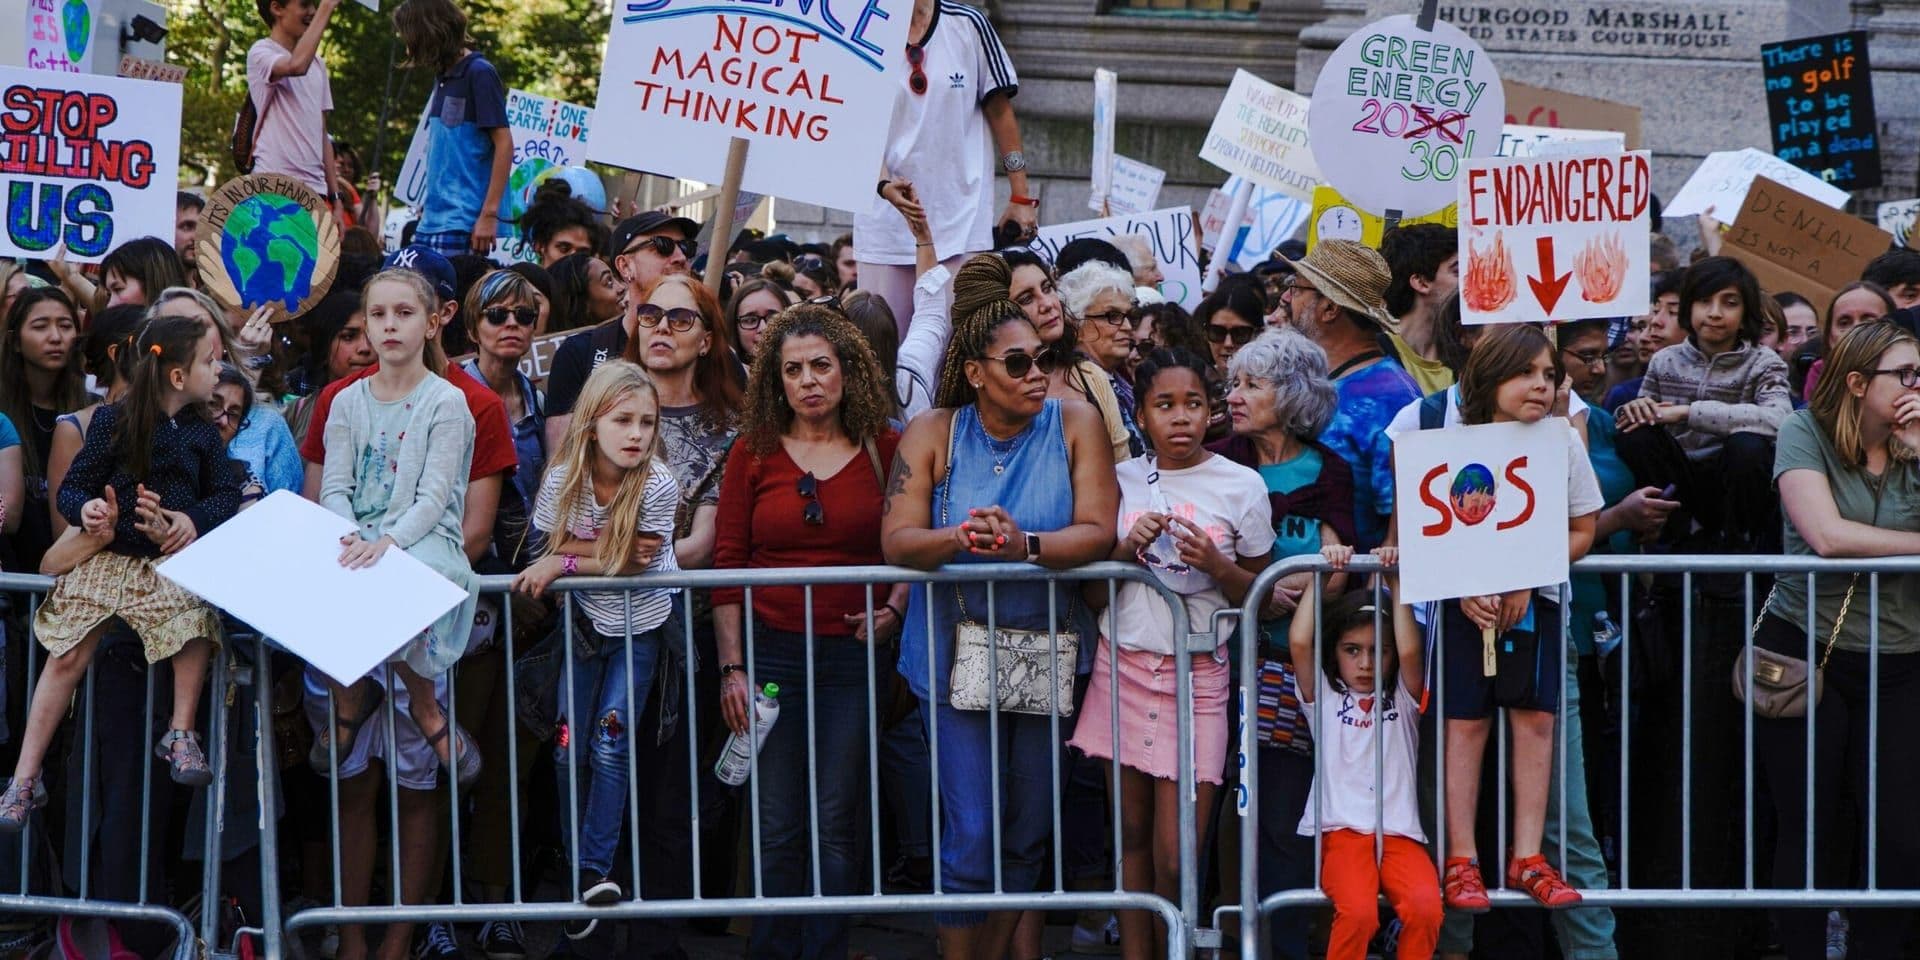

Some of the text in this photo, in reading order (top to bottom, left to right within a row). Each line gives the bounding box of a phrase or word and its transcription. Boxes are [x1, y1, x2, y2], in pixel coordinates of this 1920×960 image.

[33, 14, 58, 43] IS
[714, 15, 819, 63] NOT
[1440, 7, 1731, 31] HURGOOD MARSHALL
[1505, 27, 1577, 42] STATES
[1591, 29, 1731, 48] COURTHOUSE
[1361, 34, 1474, 77] GREEN
[1762, 38, 1853, 67] There is
[652, 46, 844, 104] MAGICAL
[1348, 67, 1486, 113] ENERGY
[1766, 55, 1855, 93] no golf
[3, 85, 117, 140] STOP
[507, 108, 549, 133] EARTH
[518, 96, 587, 126] ONE ONE
[634, 80, 829, 142] THINKING
[1786, 92, 1850, 115] to be
[1260, 115, 1308, 147] REALITY
[1779, 135, 1874, 161] on a dead
[223, 185, 244, 205] IN
[243, 177, 273, 196] OUR
[274, 178, 317, 212] HANDS
[1469, 155, 1650, 226] ENDANGERED
[7, 180, 114, 257] US
[1751, 190, 1858, 256] DENIAL
[1736, 228, 1820, 273] IS NOT A
[1419, 456, 1535, 536] SOS
